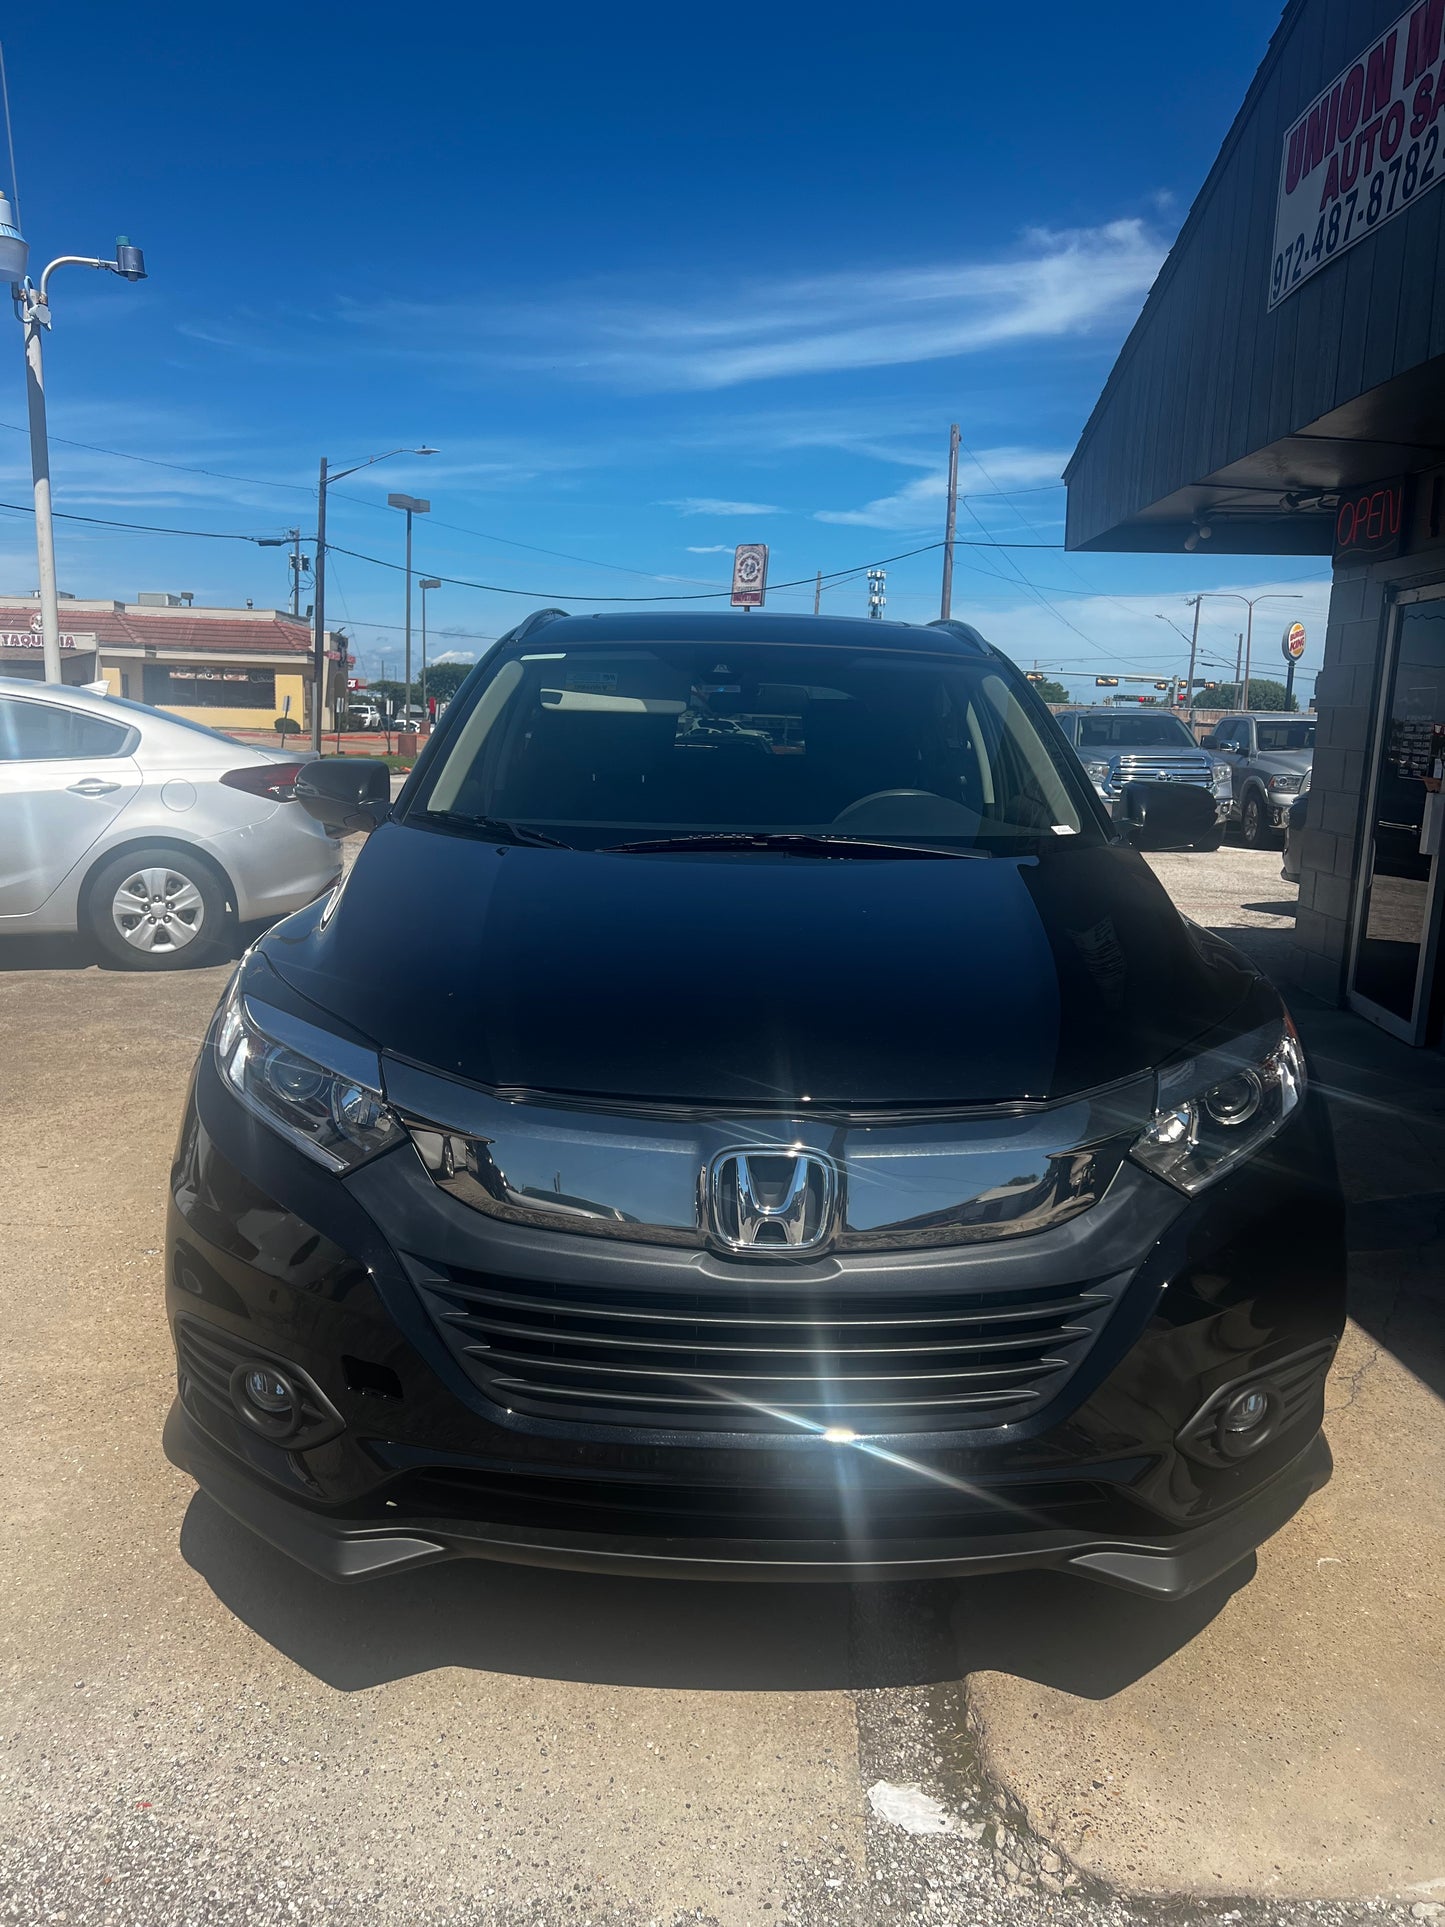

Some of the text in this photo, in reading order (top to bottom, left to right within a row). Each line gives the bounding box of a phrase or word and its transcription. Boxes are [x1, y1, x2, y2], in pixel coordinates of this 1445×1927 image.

[1285, 0, 1445, 195] UNION M
[1319, 100, 1405, 212] AUTO
[1272, 125, 1439, 300] 972-487-8782
[1337, 487, 1402, 546] OPEN
[1, 634, 76, 648] TAQUIA
